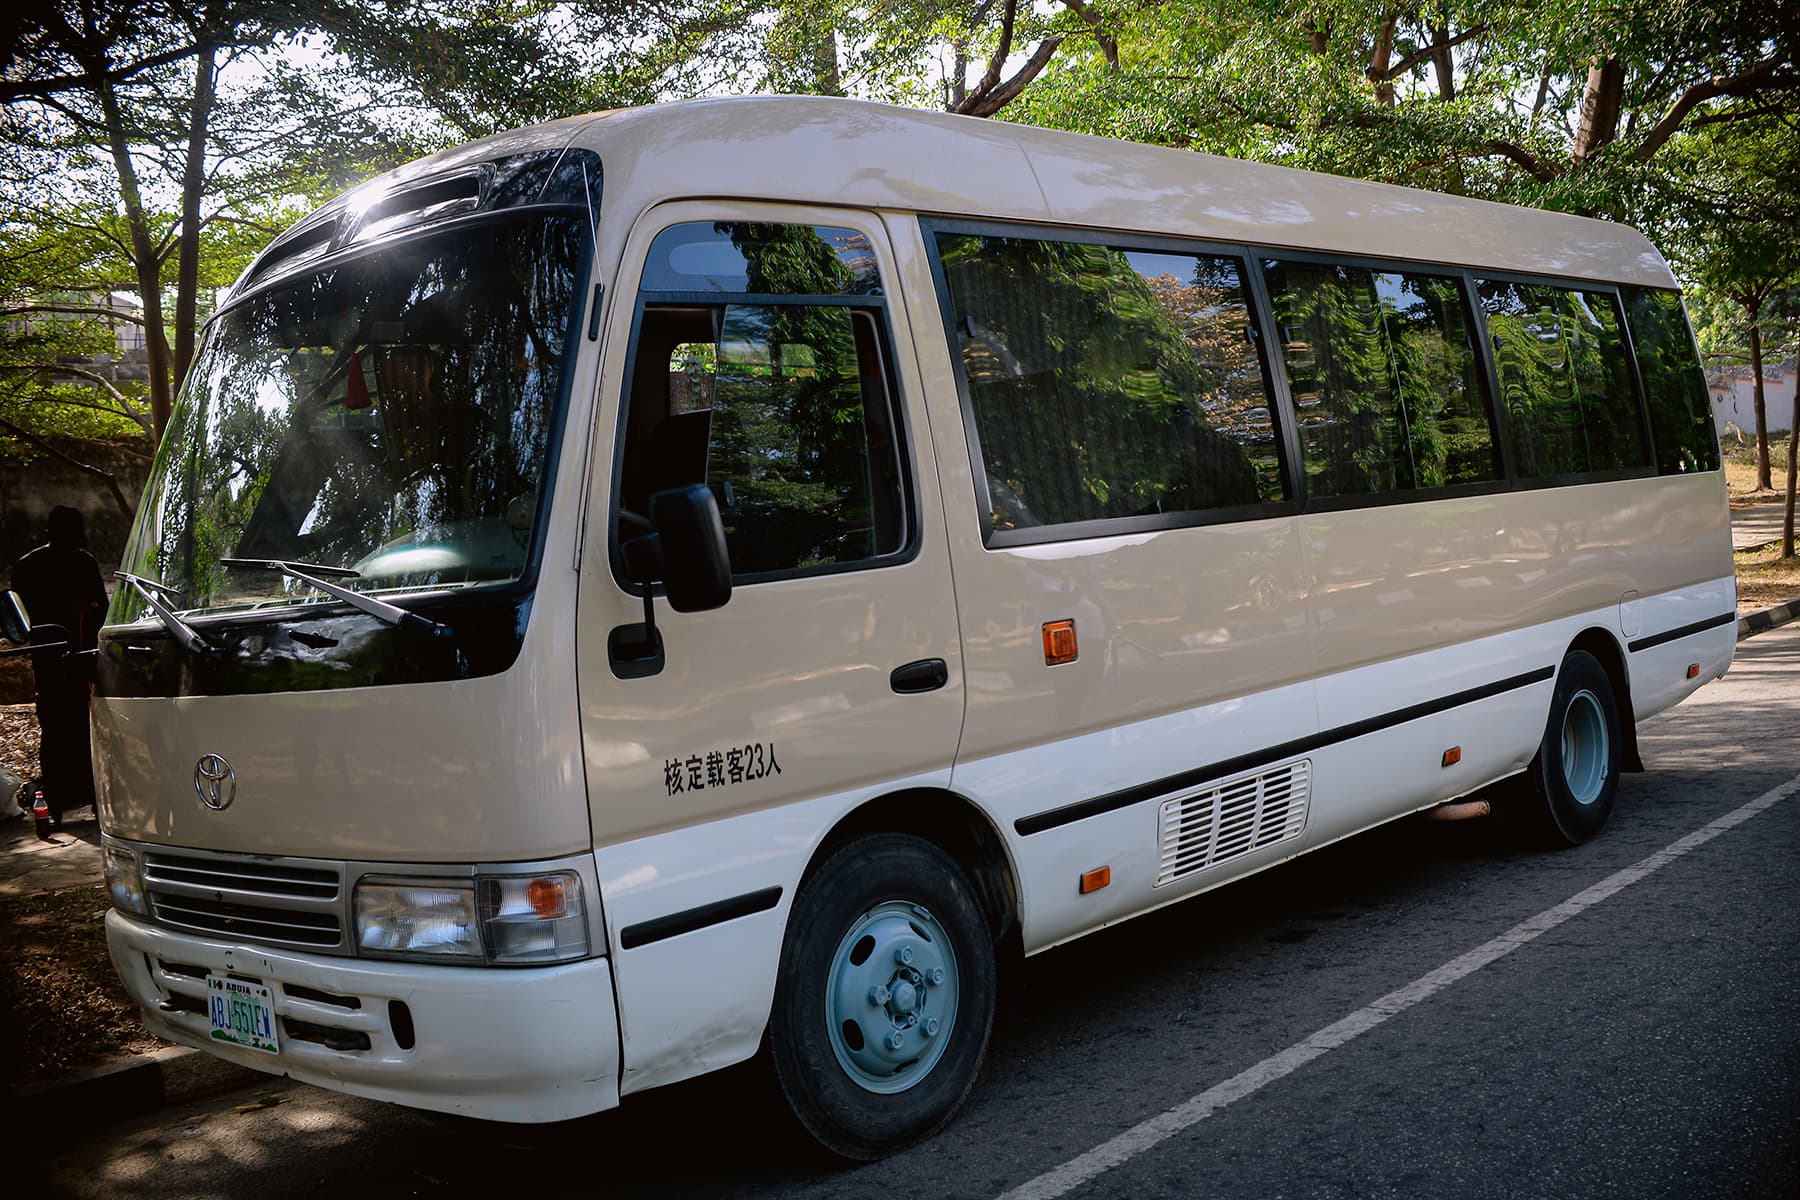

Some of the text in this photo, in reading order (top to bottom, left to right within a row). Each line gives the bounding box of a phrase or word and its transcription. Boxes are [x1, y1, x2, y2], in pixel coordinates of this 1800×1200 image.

[664, 743, 782, 796] 核定载客23人
[226, 982, 251, 995] ABUJA
